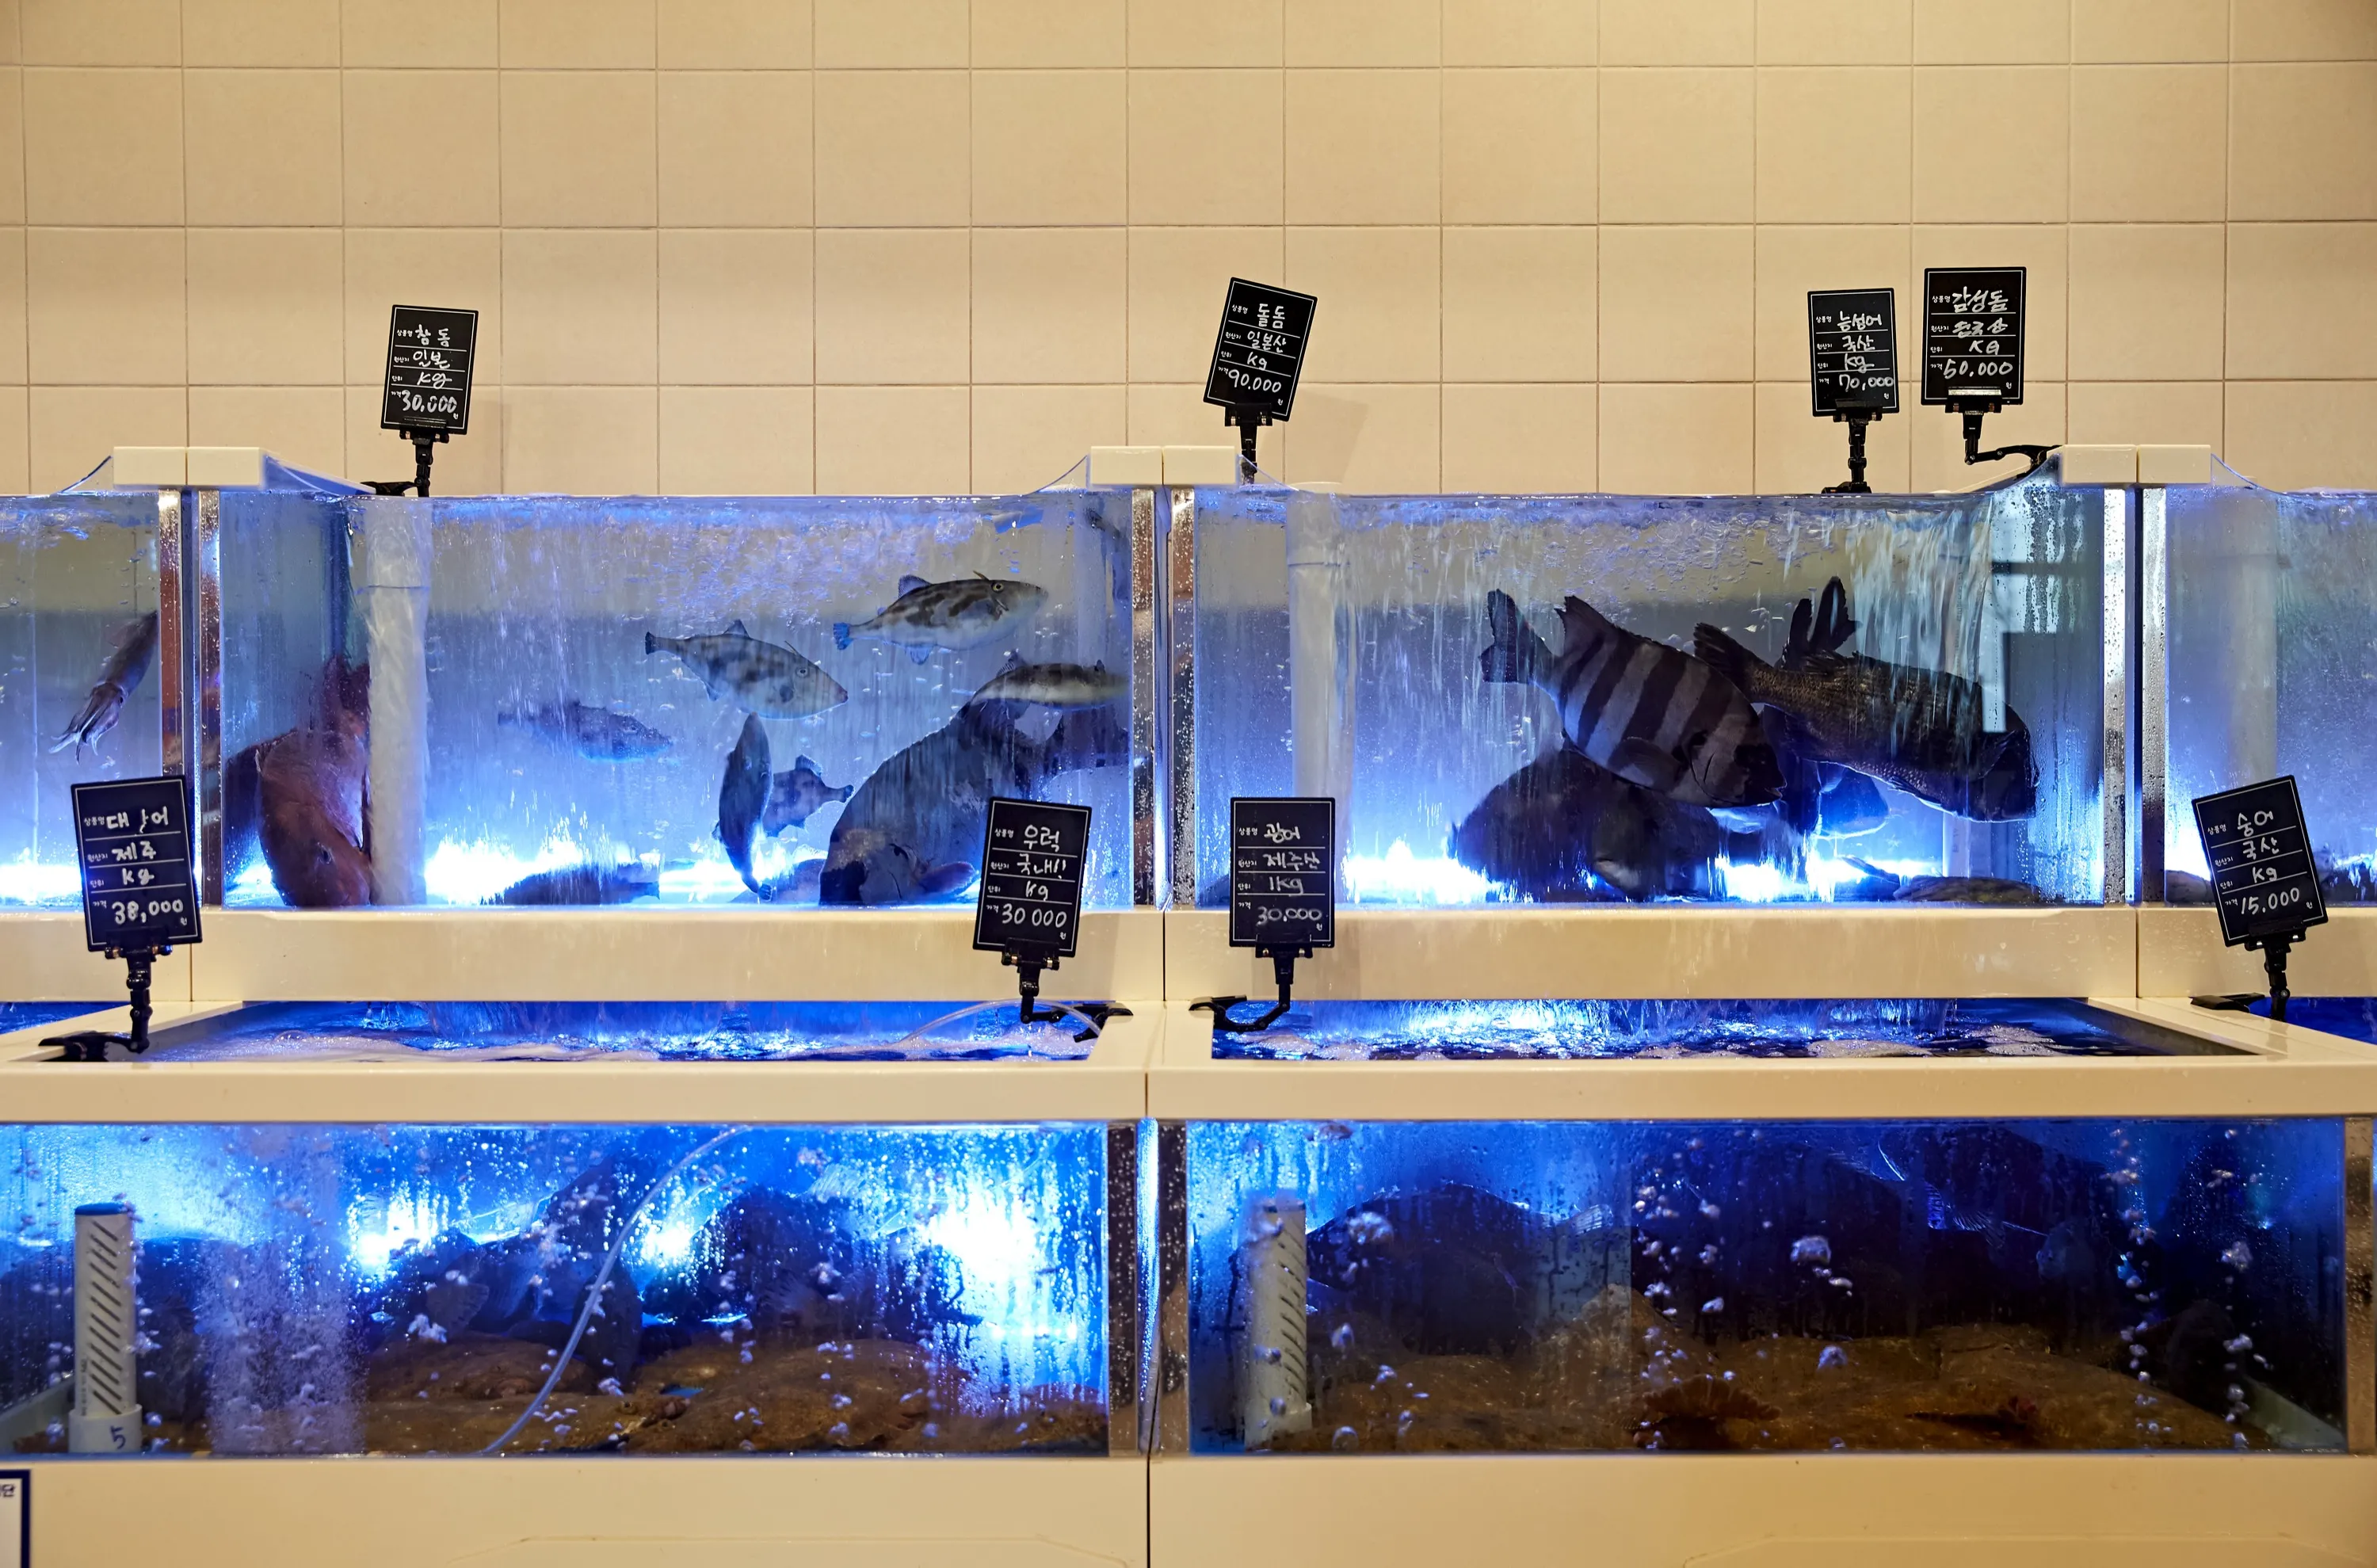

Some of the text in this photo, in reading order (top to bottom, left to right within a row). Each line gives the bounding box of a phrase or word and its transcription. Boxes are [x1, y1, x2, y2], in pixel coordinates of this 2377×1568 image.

[1952, 286, 2009, 312] 감성돔
[1232, 303, 1285, 329] 상품명 돌돔
[1247, 331, 1286, 353] 일본산
[1841, 335, 1875, 352] 국산
[413, 349, 450, 368] 일본
[84, 816, 105, 826] 상품명
[2207, 810, 2273, 837] 상품명 숭어
[994, 825, 1060, 852] 상품명 우럭
[1264, 822, 1300, 843] 광어
[87, 841, 157, 863] 원산지 제주
[1263, 852, 1321, 871] 제주산
[2215, 837, 2279, 867] 원산지 국산
[112, 899, 184, 925] 38,000
[986, 904, 998, 913] 가격
[110, 1425, 126, 1449] 5
